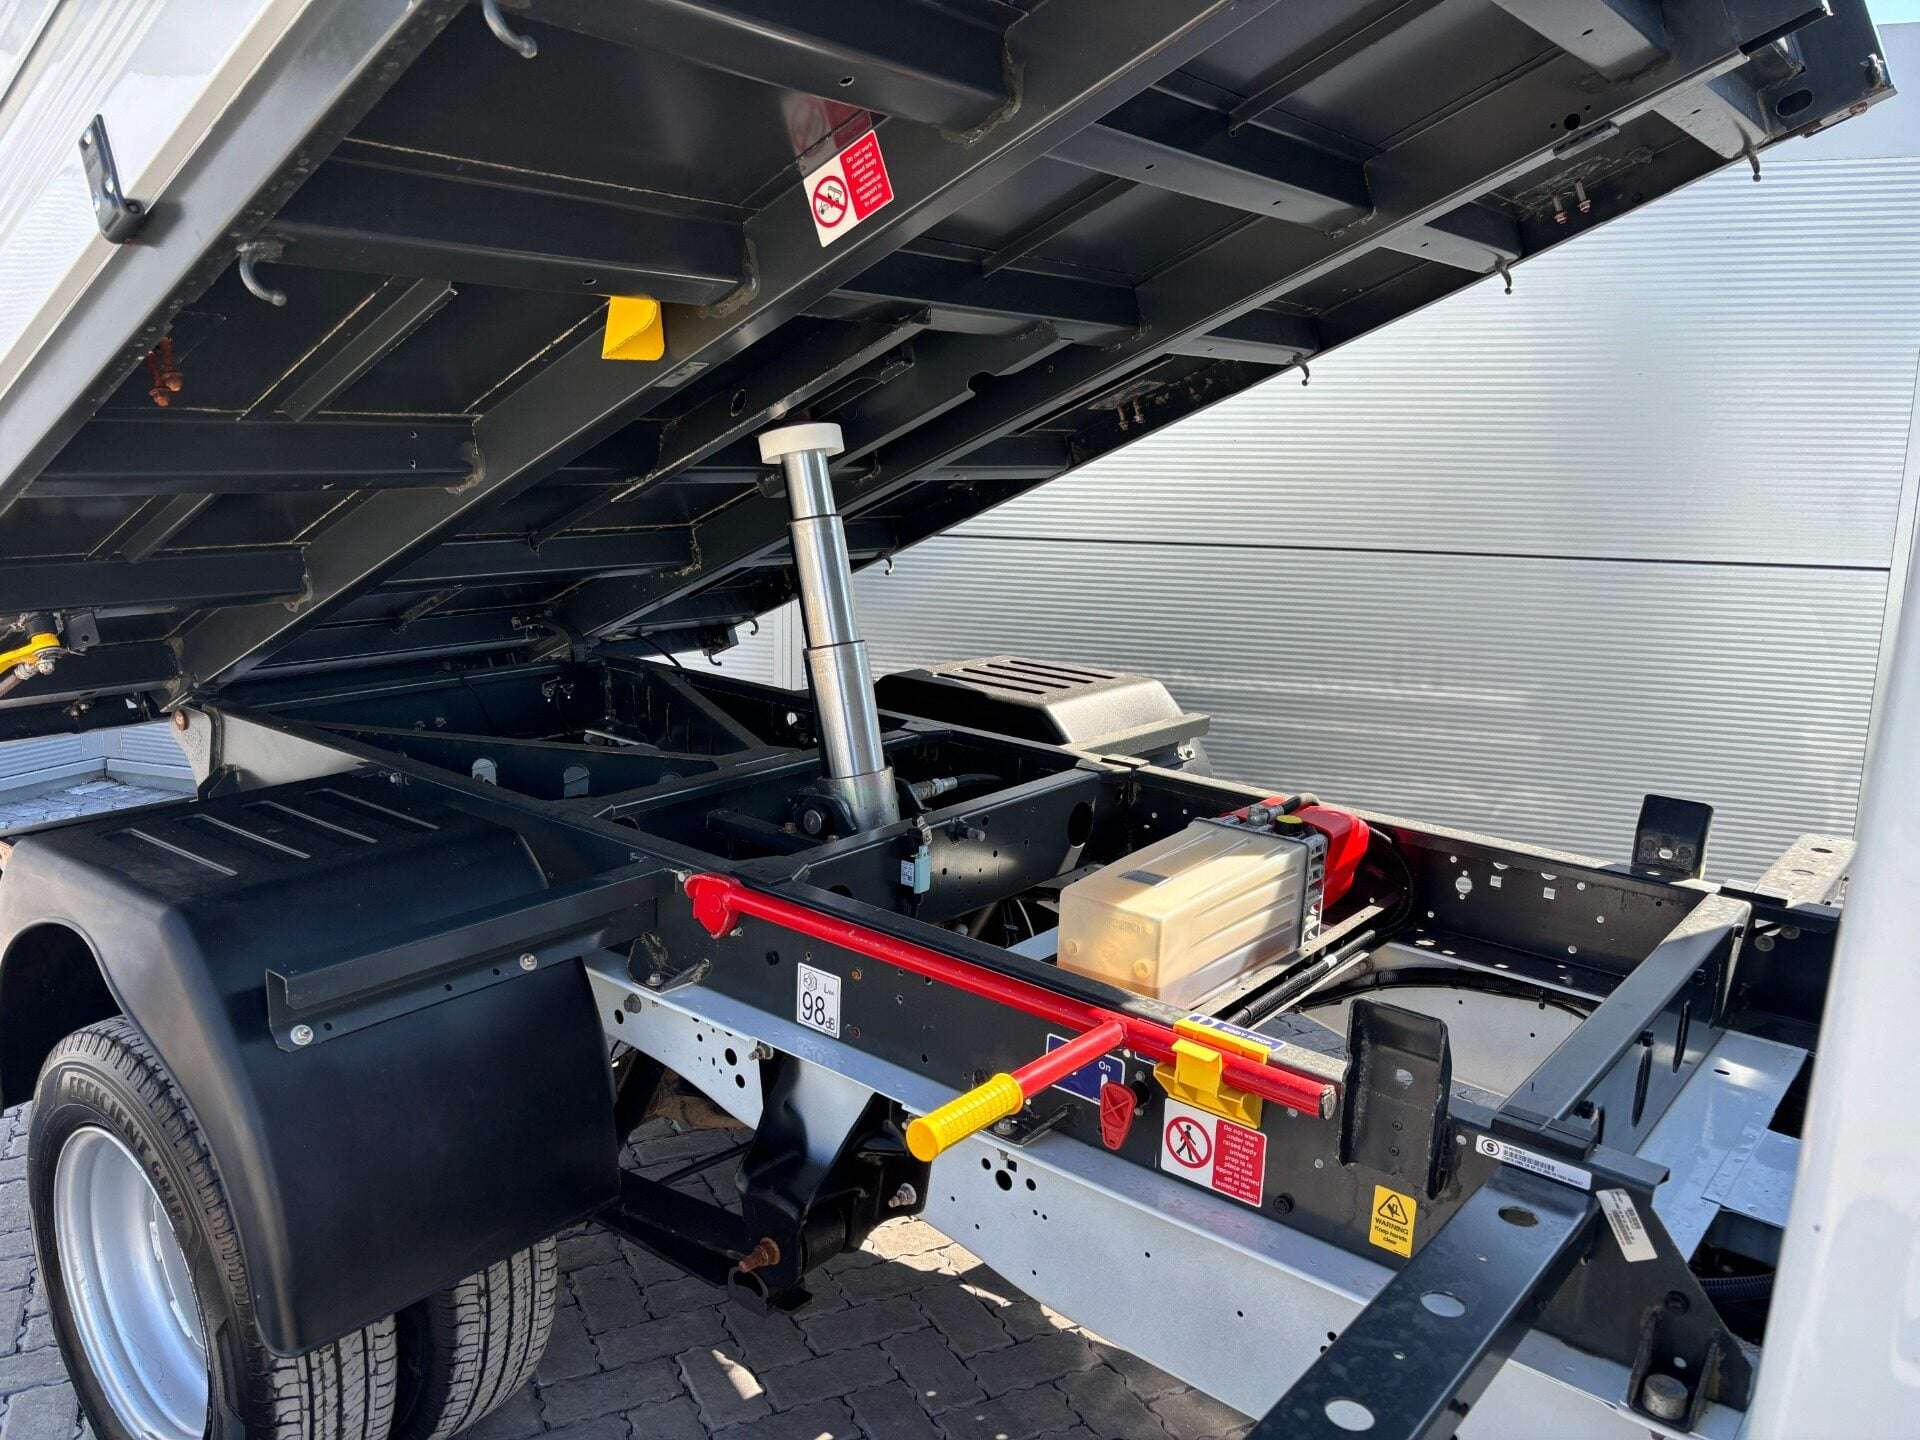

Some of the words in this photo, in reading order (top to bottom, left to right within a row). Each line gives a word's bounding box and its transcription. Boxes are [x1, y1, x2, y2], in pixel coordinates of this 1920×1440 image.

[846, 156, 854, 164] Do
[854, 149, 862, 159] not
[862, 142, 872, 153] work
[802, 992, 825, 1026] 98
[826, 1017, 835, 1030] dB
[1098, 1060, 1111, 1072] On
[69, 1076, 151, 1156] EFFICIENT
[1224, 1124, 1232, 1132] Do
[1233, 1128, 1243, 1136] not
[1244, 1132, 1258, 1142] work
[1226, 1134, 1244, 1143] under
[1244, 1140, 1254, 1148] the
[1222, 1140, 1241, 1150] raised
[1242, 1146, 1256, 1156] body
[1486, 1142, 1494, 1152] S
[1240, 1174, 1260, 1186] turned
[1238, 1188, 1258, 1200] switch
[1374, 1226, 1389, 1236] Keep
[1390, 1232, 1408, 1242] hands
[1375, 1217, 1408, 1235] WARNING
